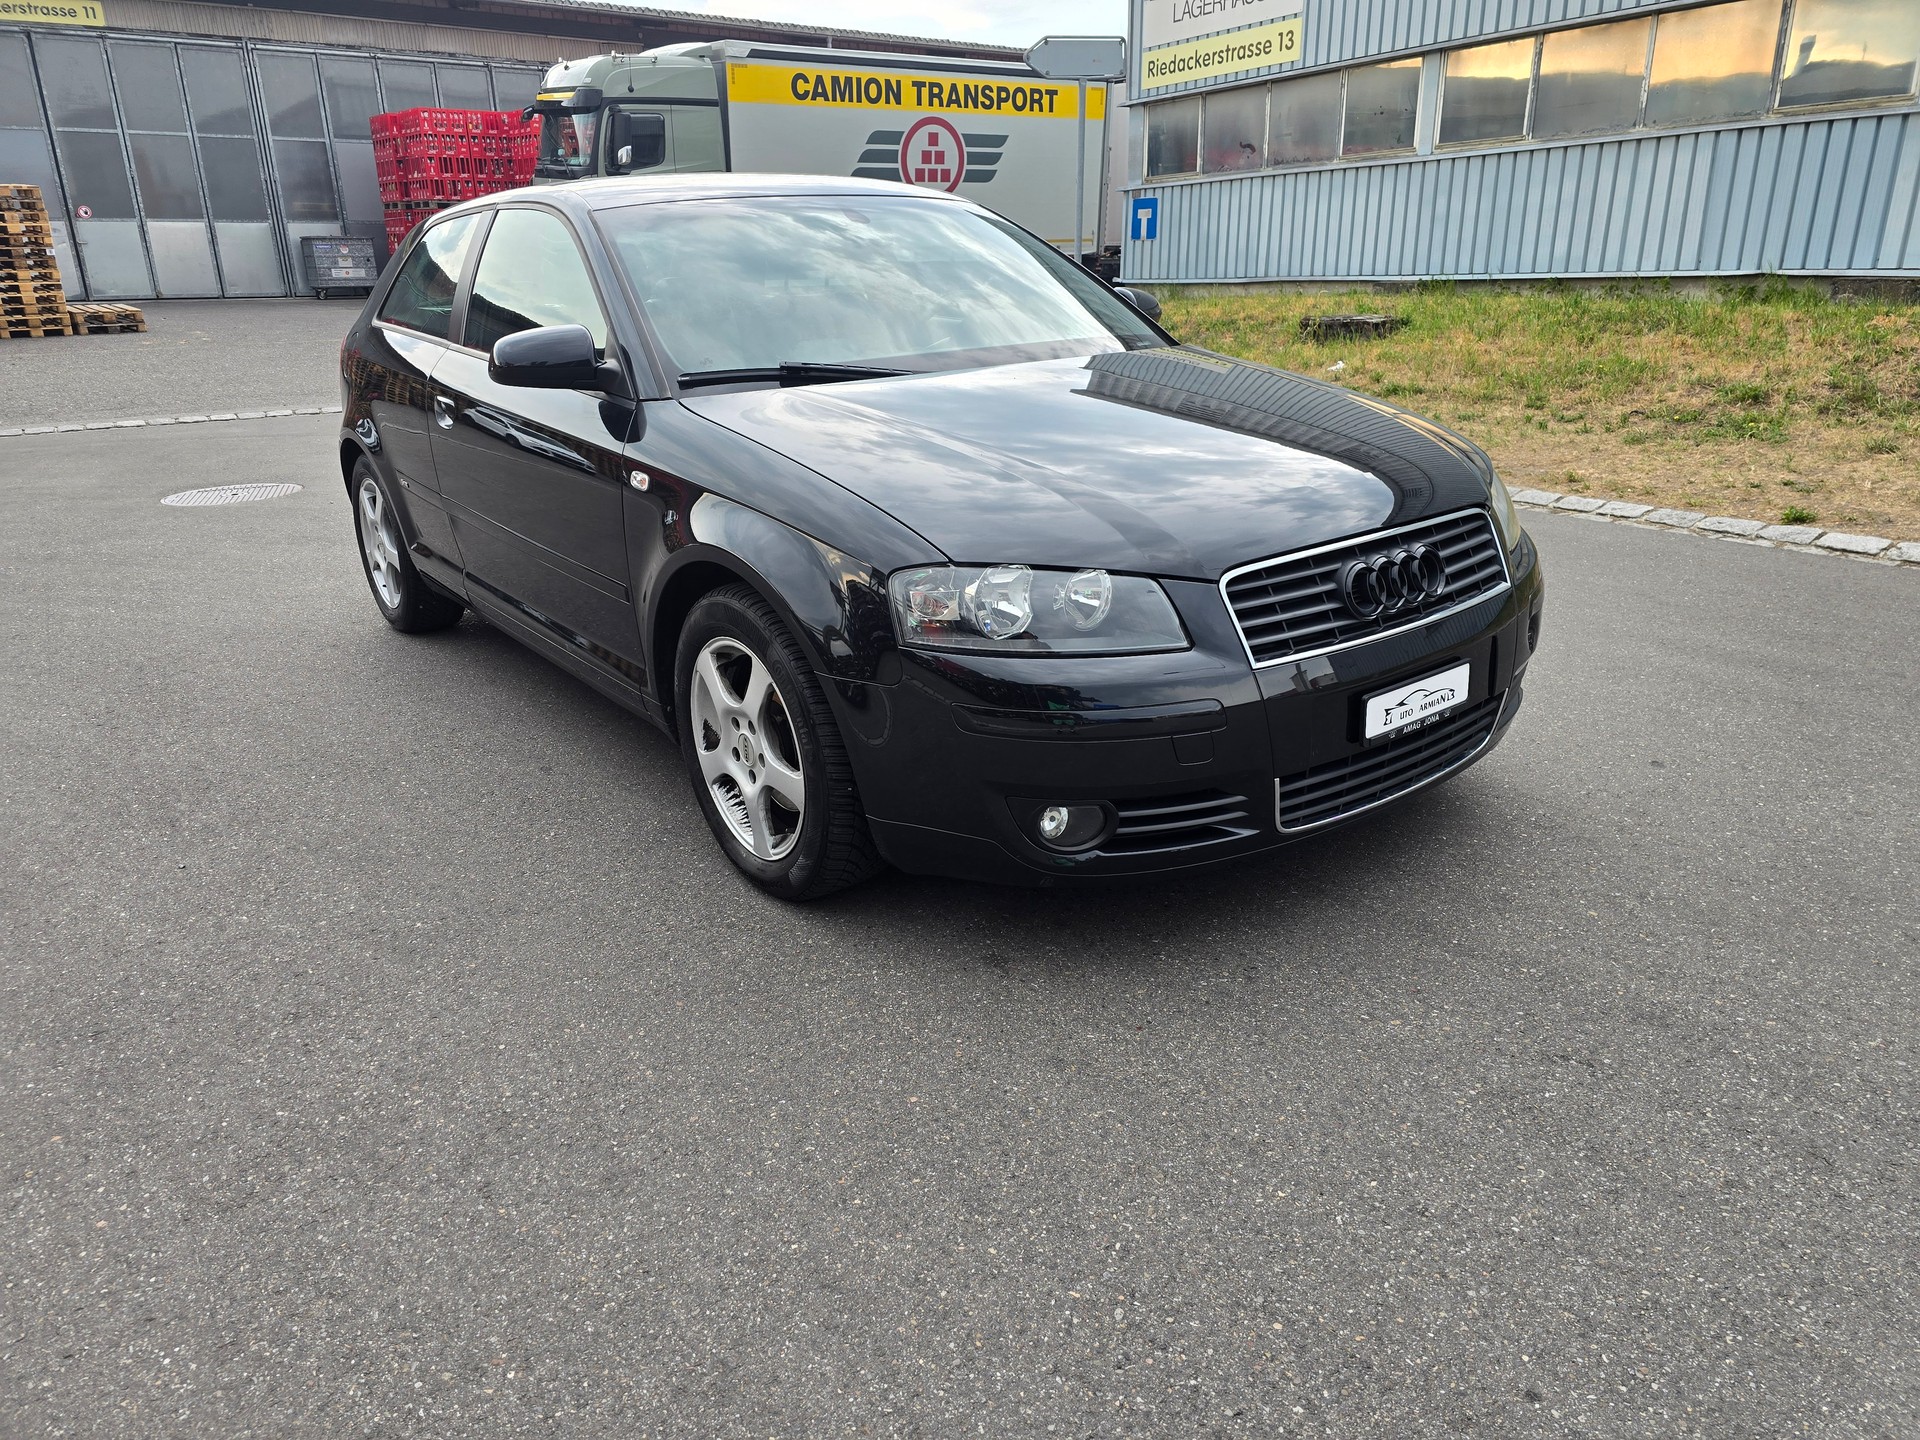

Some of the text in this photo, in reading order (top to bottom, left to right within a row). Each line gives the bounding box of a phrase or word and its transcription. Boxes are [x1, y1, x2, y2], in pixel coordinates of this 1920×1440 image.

[0, 2, 97, 20] erstrasse 11
[1173, 0, 1264, 23] LAGER
[1147, 29, 1295, 78] Riedackerstrasse 13
[790, 72, 1059, 114] CAMION TRANSPORT
[1402, 713, 1440, 735] AMAG JONA
